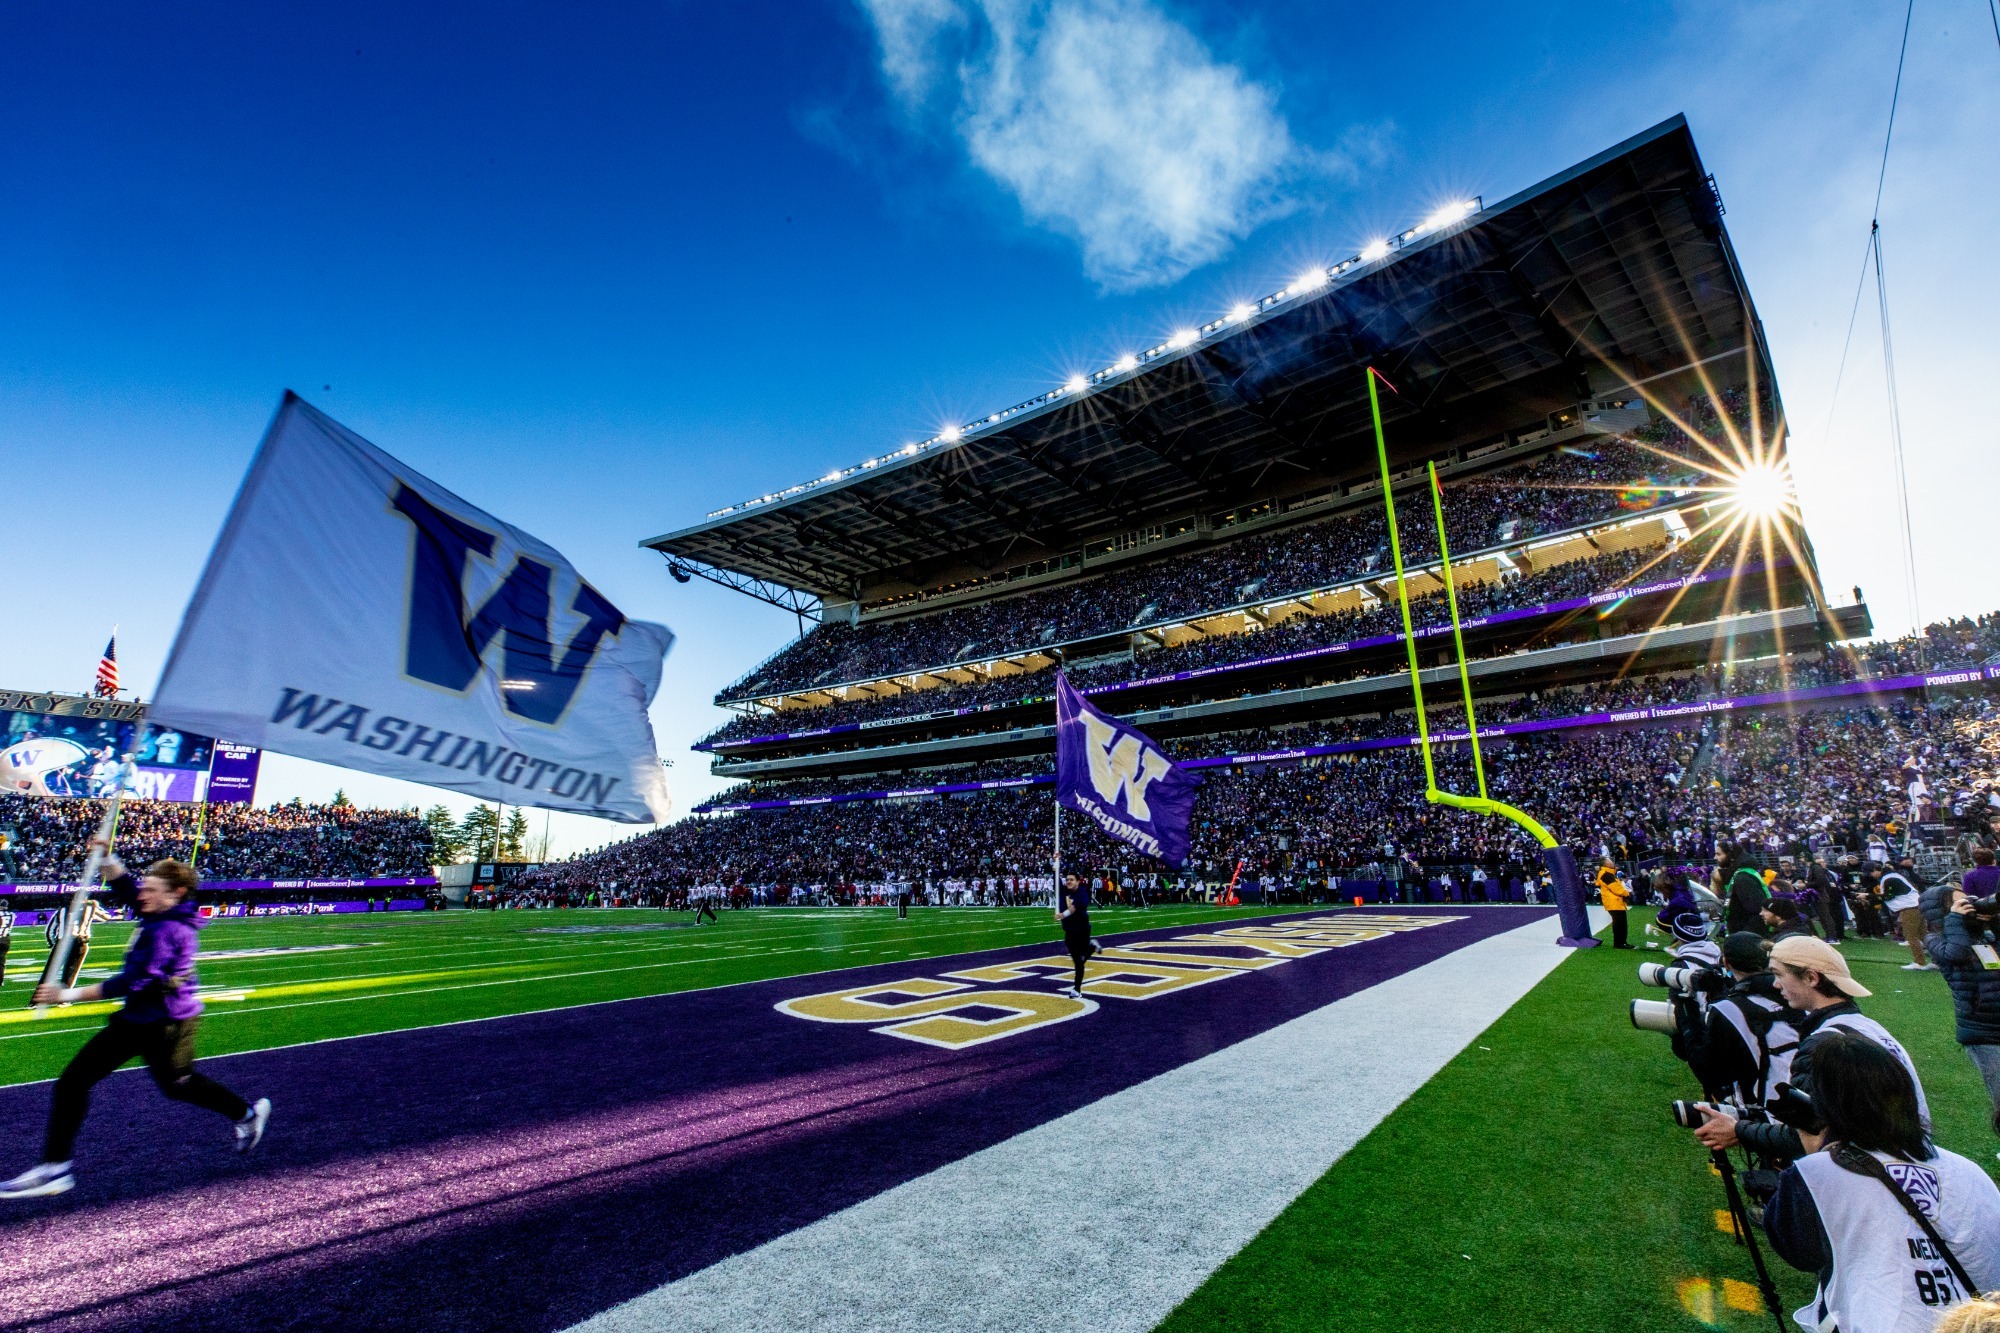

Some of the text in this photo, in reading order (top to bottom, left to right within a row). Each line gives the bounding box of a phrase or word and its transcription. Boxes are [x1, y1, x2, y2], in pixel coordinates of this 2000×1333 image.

[1589, 591, 1617, 604] POWERED
[1617, 590, 1625, 598] BY
[1687, 575, 1707, 585] Bank
[385, 476, 627, 731] W
[1396, 630, 1418, 641] POWED
[1418, 629, 1425, 637] BY
[1472, 618, 1488, 627] Bank
[1235, 660, 1261, 669] GREATEST
[1293, 650, 1317, 658] COLLEGE
[1318, 644, 1347, 654] FOOTBALL
[1088, 686, 1108, 694] NEXT
[1127, 679, 1145, 688] HUSKY
[1145, 675, 1176, 685] ATHLETICS
[1926, 673, 1969, 685] POWERED
[1969, 672, 1982, 680] BY
[1610, 711, 1639, 722] POWERED
[1640, 710, 1648, 719] BY
[1712, 702, 1734, 710] Bank
[271, 687, 622, 802] WASHINGTON
[1411, 735, 1433, 744] POWED
[1489, 728, 1507, 736] Bank
[216, 744, 257, 753] HELMET
[225, 752, 247, 760] CAR
[1078, 708, 1173, 823] W
[1232, 755, 1250, 763] POWERED
[15, 885, 48, 893] POWERED
[48, 884, 58, 892] BY
[230, 906, 241, 916] BY
[774, 913, 1472, 1050] HUSKIES
[1888, 1164, 1939, 1202] PAC
